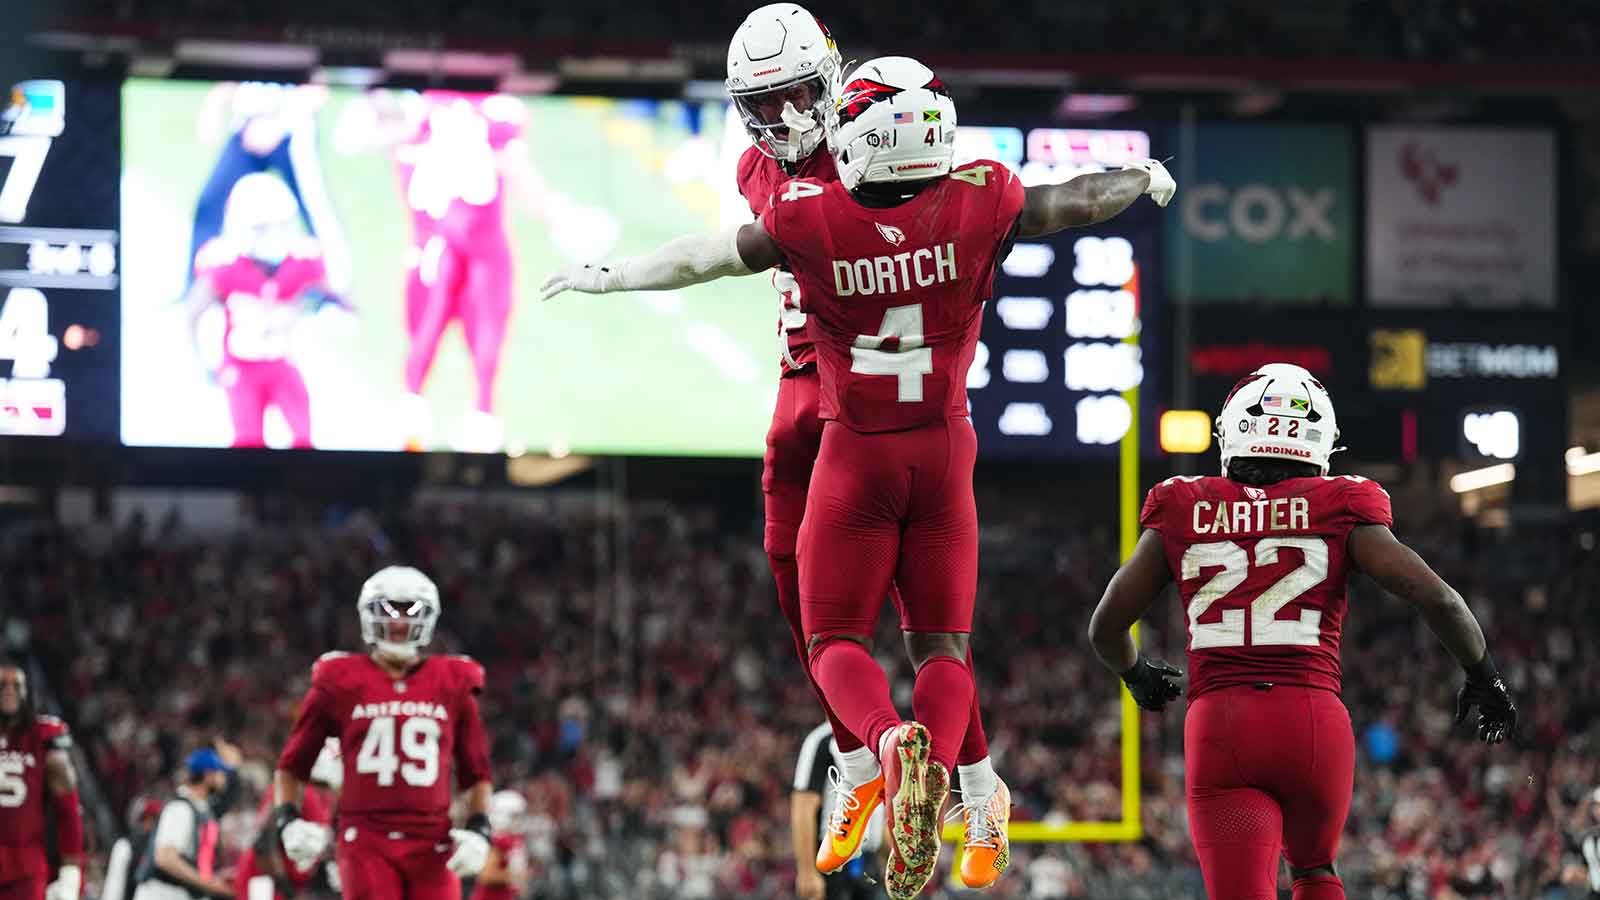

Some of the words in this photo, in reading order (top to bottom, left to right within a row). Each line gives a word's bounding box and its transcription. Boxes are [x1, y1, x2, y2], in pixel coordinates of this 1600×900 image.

[924, 127, 935, 146] 4
[781, 181, 824, 201] 4
[832, 243, 958, 297] DORTCH
[850, 303, 933, 402] 4
[1250, 446, 1311, 457] CARDINALS
[1192, 497, 1310, 534] CARTER
[1180, 537, 1329, 651] 22
[356, 716, 442, 787] 49
